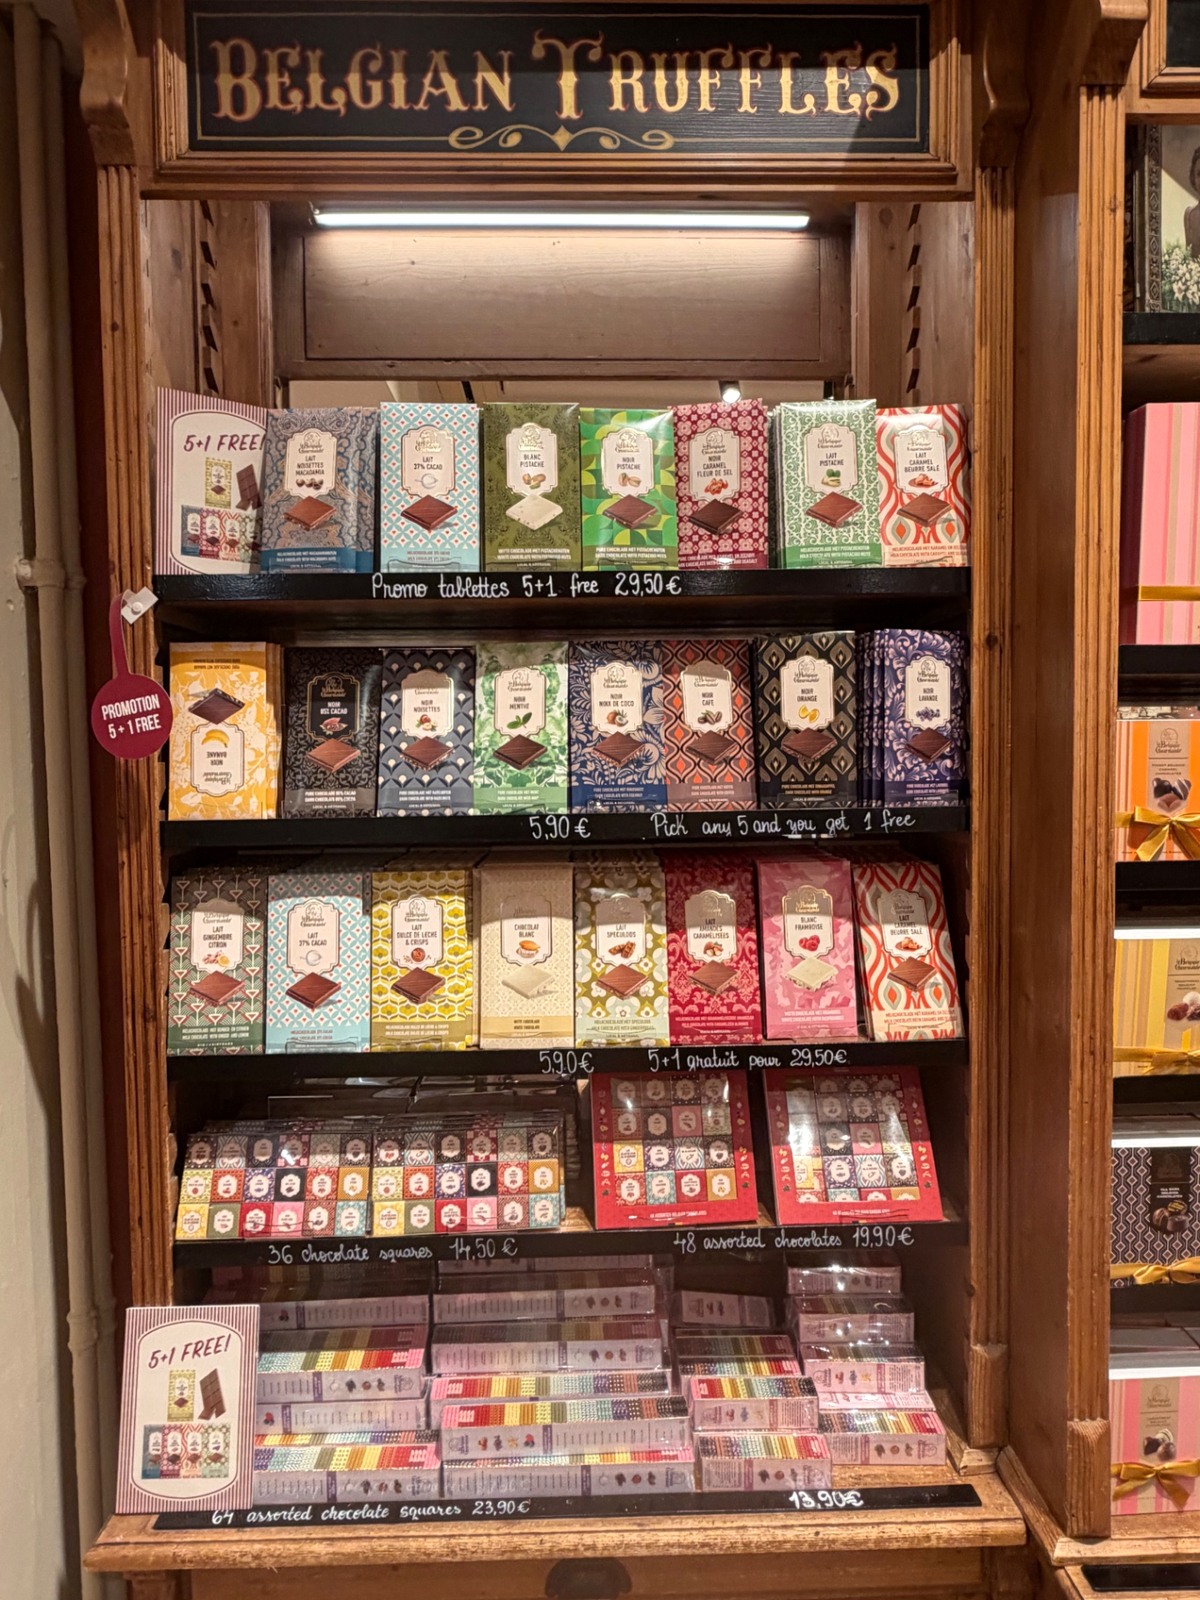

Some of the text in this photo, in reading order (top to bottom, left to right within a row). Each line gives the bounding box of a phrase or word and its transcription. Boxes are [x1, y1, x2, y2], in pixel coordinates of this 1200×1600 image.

[209, 28, 901, 122] BELGIAN TRUFFLES
[183, 434, 212, 452] 5+1
[426, 463, 443, 471] CACAO
[616, 463, 641, 471] PISTACHE
[819, 459, 845, 467] PISTACHE
[372, 573, 428, 598] Promo
[438, 576, 510, 598] tablettes
[522, 575, 556, 598] 5+1
[571, 573, 599, 598] free
[101, 694, 161, 721] PROMOTION
[918, 694, 938, 702] LAVANDE
[107, 724, 117, 740] 5
[127, 720, 135, 735] 1
[135, 714, 162, 732] FREE
[206, 751, 228, 759] BANANE
[651, 813, 689, 836] Pick
[702, 820, 733, 837] any
[738, 817, 749, 836] 5
[753, 816, 782, 834] and
[786, 819, 817, 837] you
[825, 816, 850, 836] get
[863, 812, 873, 828] 1
[880, 809, 916, 827] free
[794, 923, 824, 931] FRAMBOISE
[800, 916, 817, 924] BLANC
[890, 928, 910, 936] BEURRE
[410, 938, 429, 946] CRISPS
[648, 1048, 681, 1073] 5+1
[687, 1050, 740, 1072] gratuit
[749, 1055, 782, 1071] pour
[673, 1231, 696, 1254] 48
[703, 1228, 766, 1249] assorted
[774, 1227, 843, 1248] chocolates
[268, 1244, 293, 1264] 36
[301, 1243, 370, 1262] chocolate
[379, 1247, 433, 1264] squares
[148, 1333, 232, 1369] 5+1 FREE!
[211, 1509, 234, 1526] 64
[246, 1504, 314, 1523] assorted
[321, 1505, 390, 1522] chocolate
[400, 1504, 462, 1521] squares
